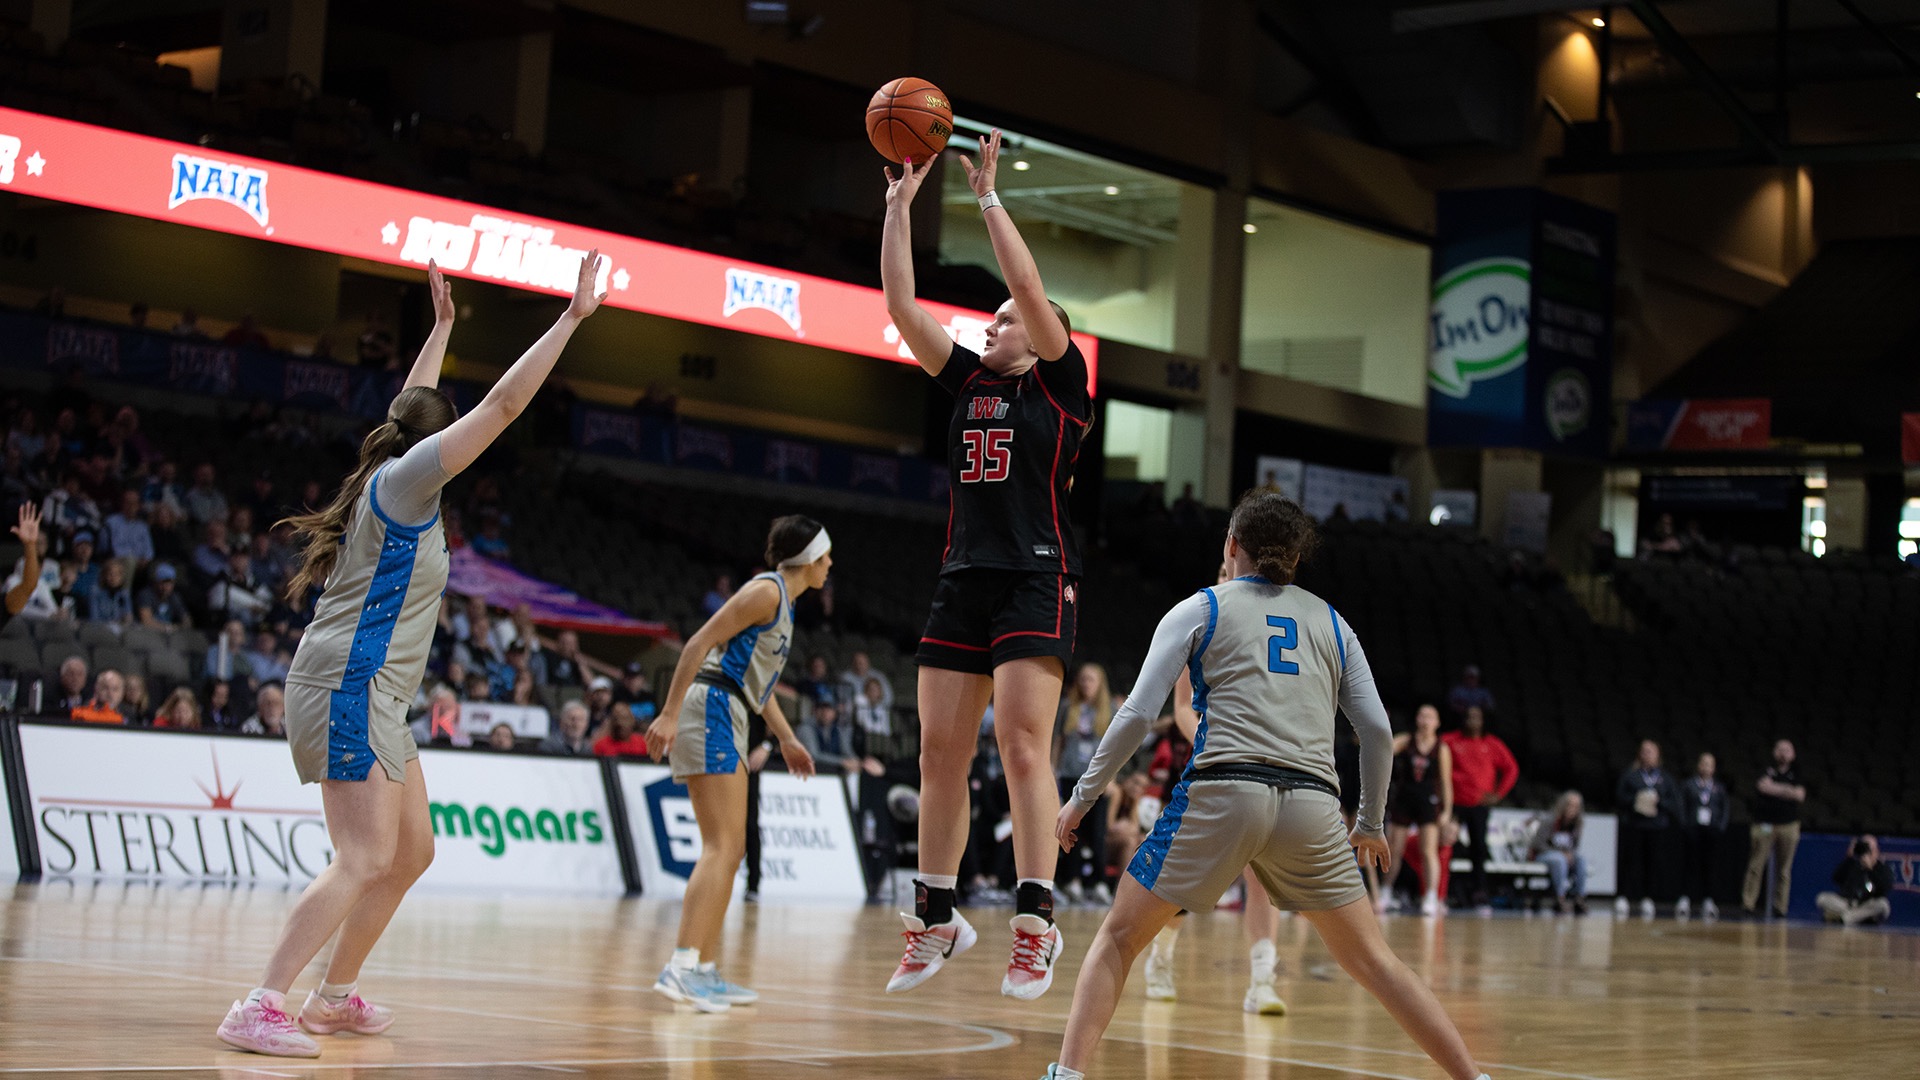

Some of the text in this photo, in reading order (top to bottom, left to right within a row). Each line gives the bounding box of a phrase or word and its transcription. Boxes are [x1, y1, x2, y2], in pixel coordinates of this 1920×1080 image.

[171, 156, 266, 221] NAIA
[726, 270, 799, 326] NAIA
[967, 396, 1009, 420] IWU
[960, 428, 1014, 483] 35
[1266, 614, 1300, 676] 2
[429, 801, 603, 857] mgaars
[759, 793, 821, 818] URITY
[40, 805, 335, 879] STERLING
[759, 826, 838, 851] TIONAL
[761, 858, 798, 881] NK
